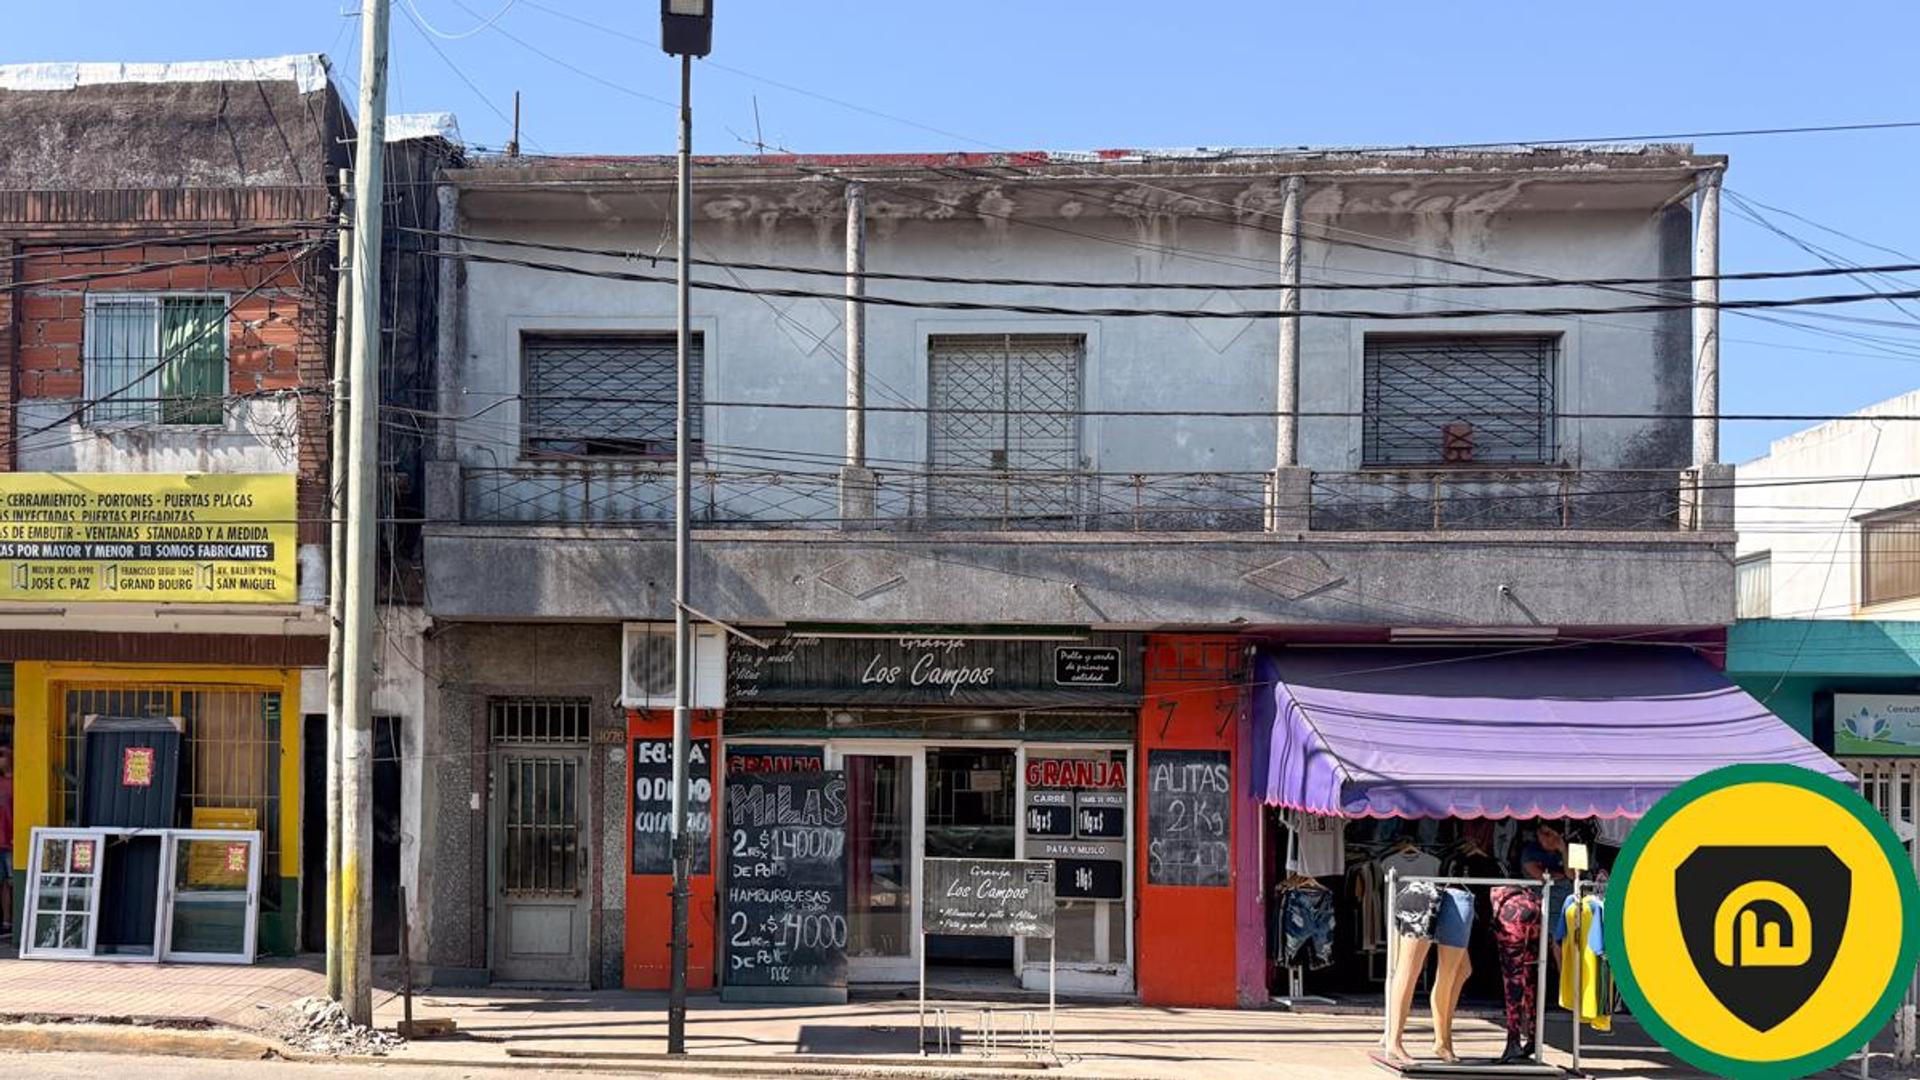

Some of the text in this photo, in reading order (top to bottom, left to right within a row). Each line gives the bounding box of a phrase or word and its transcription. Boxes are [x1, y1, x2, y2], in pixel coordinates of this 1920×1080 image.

[7, 494, 87, 507] CERRAMIENTOS
[97, 494, 154, 507] PORTONES
[164, 494, 210, 507] PUERTAS
[213, 494, 253, 508] PLACAS
[12, 526, 27, 539] DE
[28, 526, 73, 539] EMBUTIR
[85, 526, 140, 540] VENTANAS
[147, 526, 203, 540] STANDARD
[206, 527, 213, 540] Y
[216, 527, 224, 540] A
[227, 527, 269, 540] MEDIDA
[17, 544, 39, 557] POR
[42, 544, 81, 557] MAYOR
[84, 545, 93, 557] Y
[94, 545, 135, 558] MENOR
[155, 545, 195, 558] SOMOS
[198, 545, 268, 558] FABRICANTES
[31, 578, 90, 590] JOSE C. PAZ
[120, 579, 193, 591] GRAND BOURG
[216, 579, 277, 591] SAN MIGUEL
[861, 653, 995, 697] Los Campos
[1025, 760, 1128, 788] GRANJA
[1046, 845, 1067, 854] PATA
[970, 866, 1011, 880] Granja
[946, 879, 1029, 907] Los Campos
